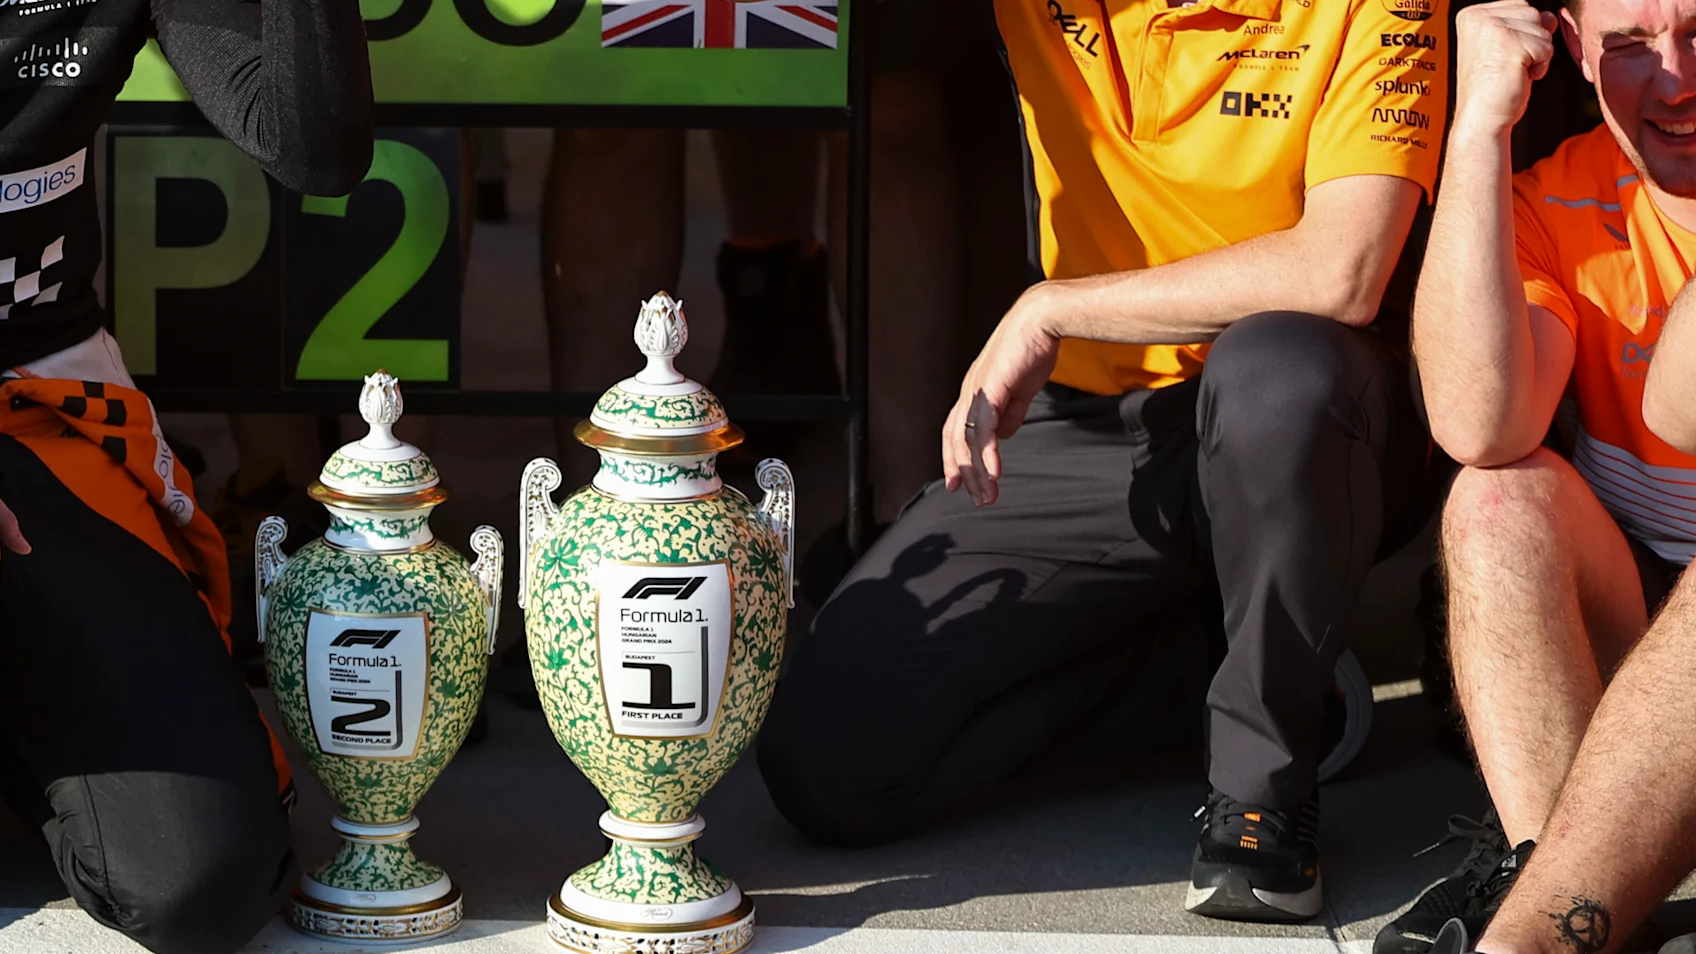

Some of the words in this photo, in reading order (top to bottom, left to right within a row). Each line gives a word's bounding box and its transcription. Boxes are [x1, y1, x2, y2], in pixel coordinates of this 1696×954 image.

[19, 2, 62, 16] FORMULA
[1243, 23, 1285, 36] Andrea
[1216, 48, 1301, 62] McLaren
[17, 62, 81, 79] CISCO
[1220, 90, 1293, 119] OKX
[621, 608, 693, 623] Formula
[329, 653, 389, 667] Formula
[621, 661, 696, 710] 1
[330, 695, 391, 736] 2
[621, 710, 649, 719] FIRST
[651, 712, 683, 720] PLACE
[331, 734, 364, 743] SECOND
